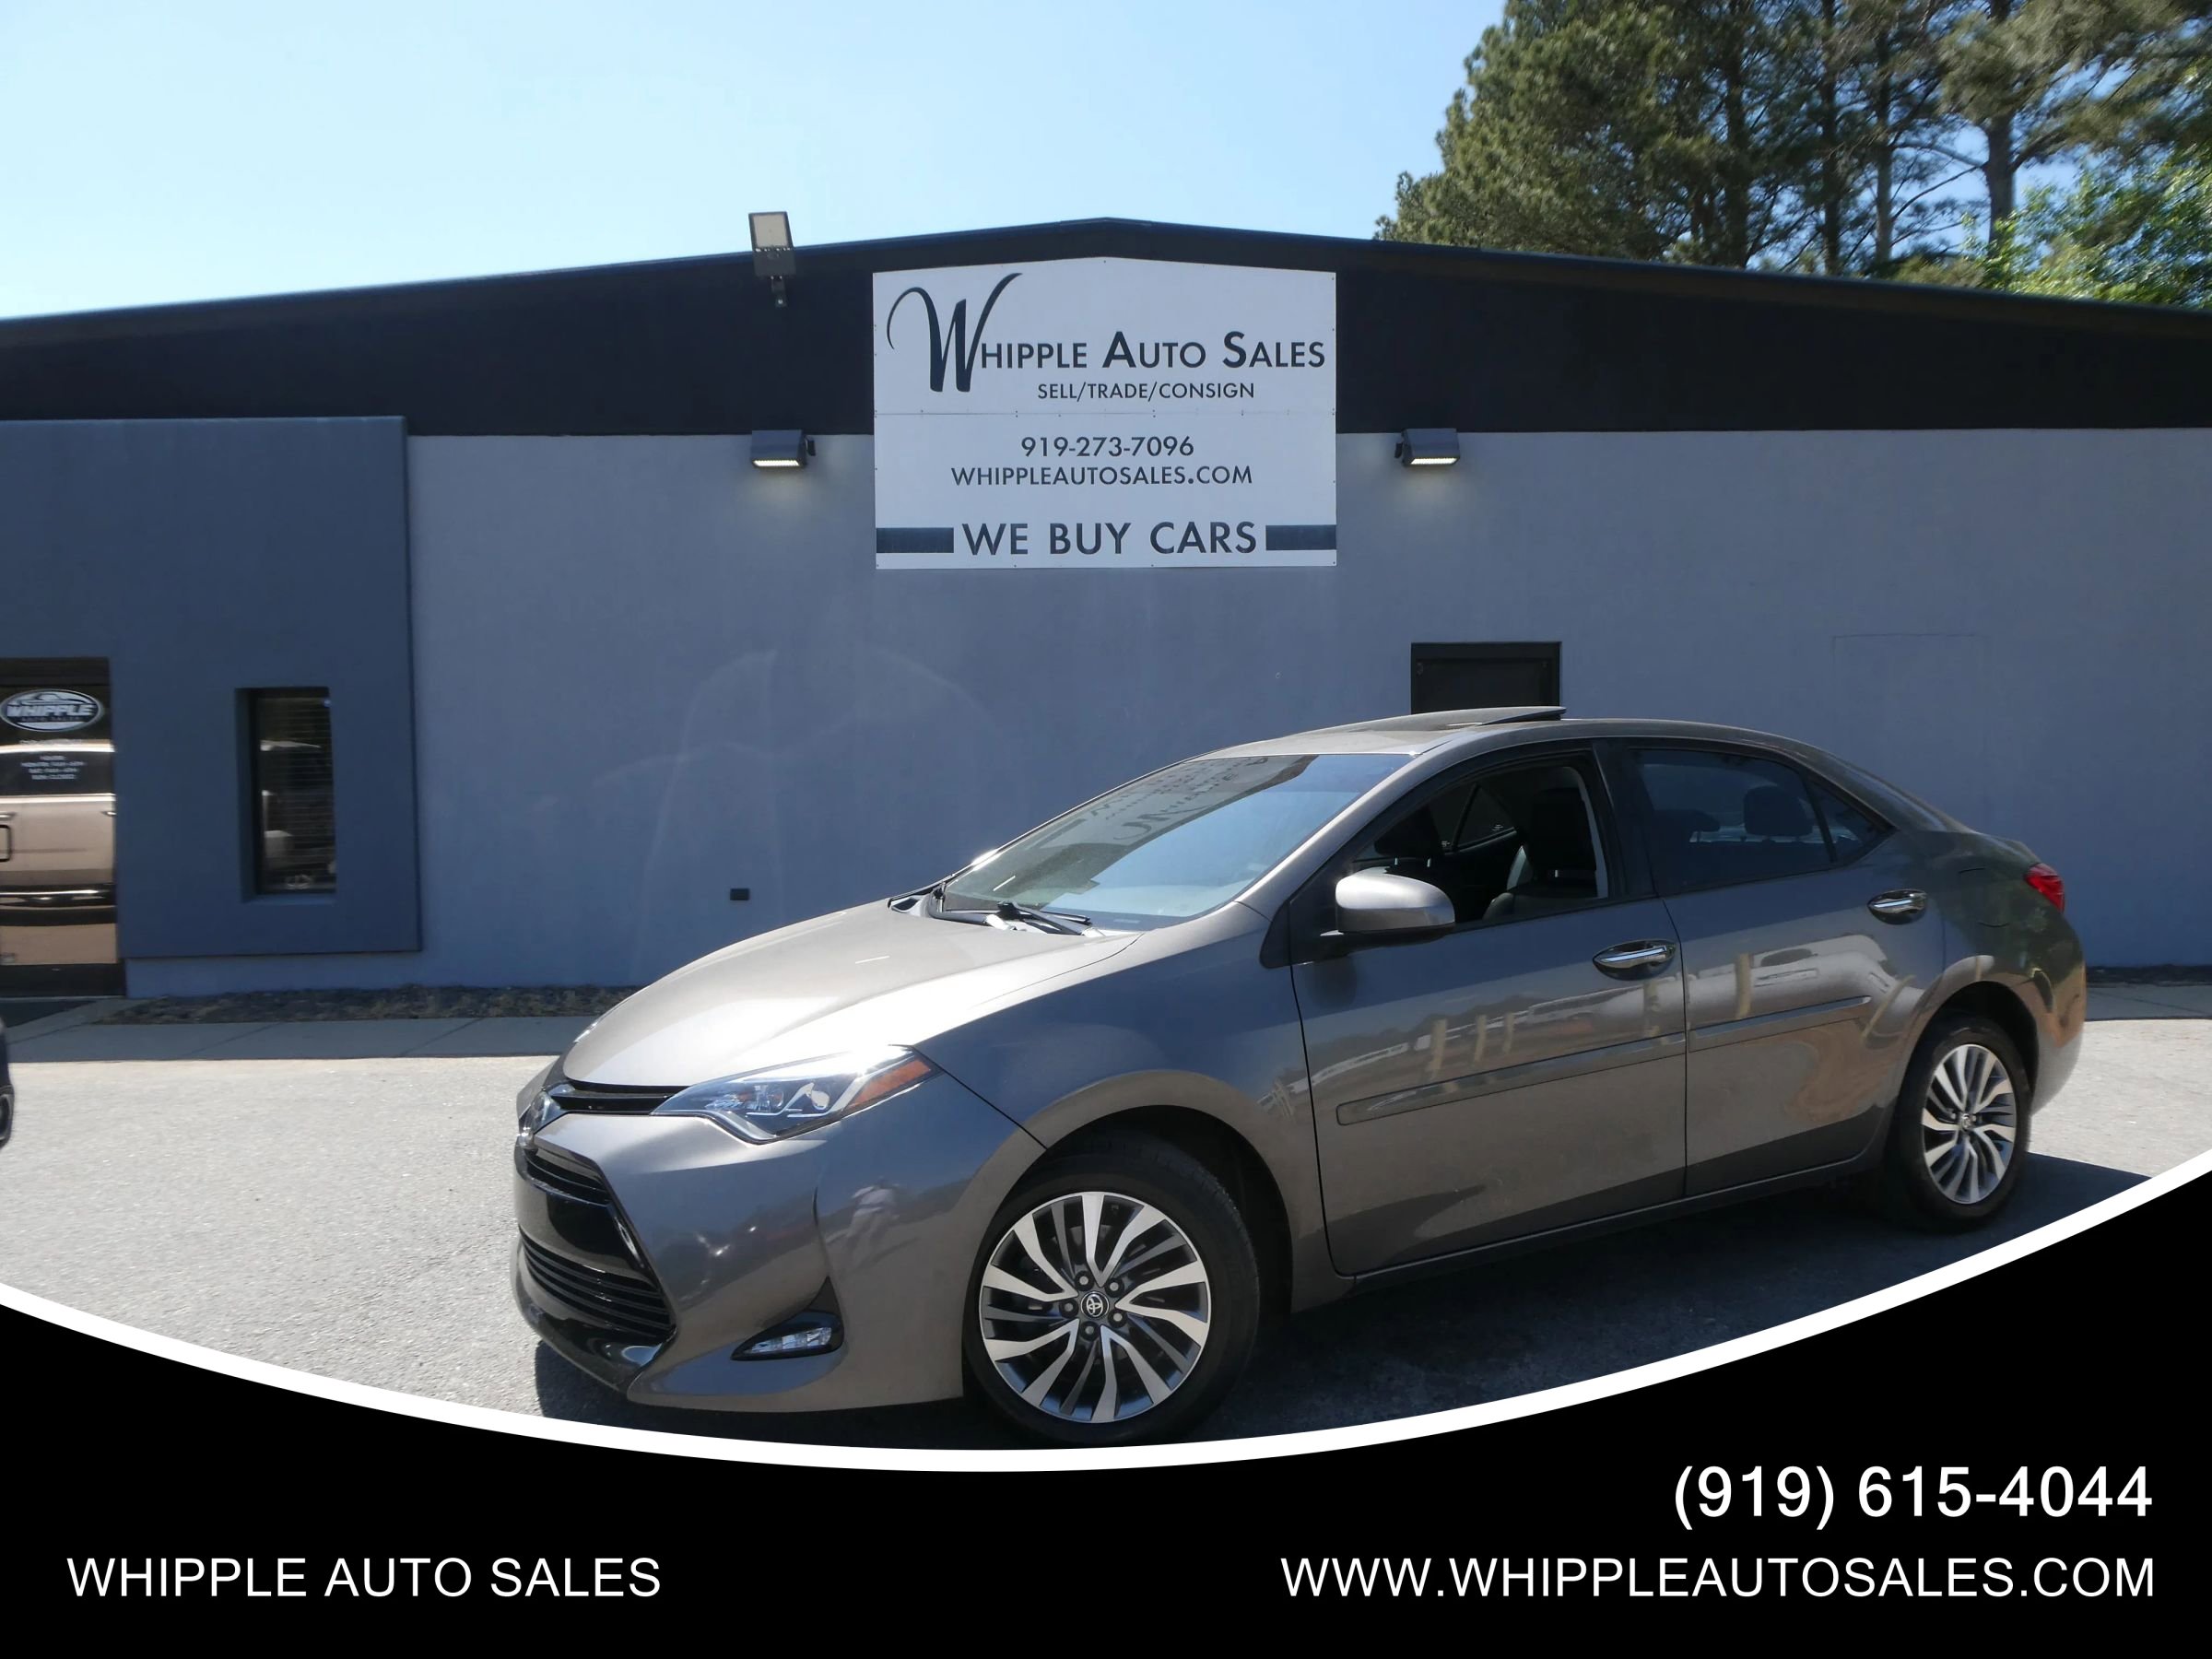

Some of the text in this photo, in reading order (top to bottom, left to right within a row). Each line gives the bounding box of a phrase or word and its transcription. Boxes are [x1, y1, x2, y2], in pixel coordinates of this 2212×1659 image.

[887, 273, 1325, 393] WHIPPLE AUTO SALES
[1037, 381, 1254, 403] SELL/TRADE/CONSIGN
[1020, 435, 1194, 457] 919-273-7096
[950, 465, 1253, 486] WHIPPLEAUTOSALES.COM
[961, 521, 1257, 556] WE BUY CARS
